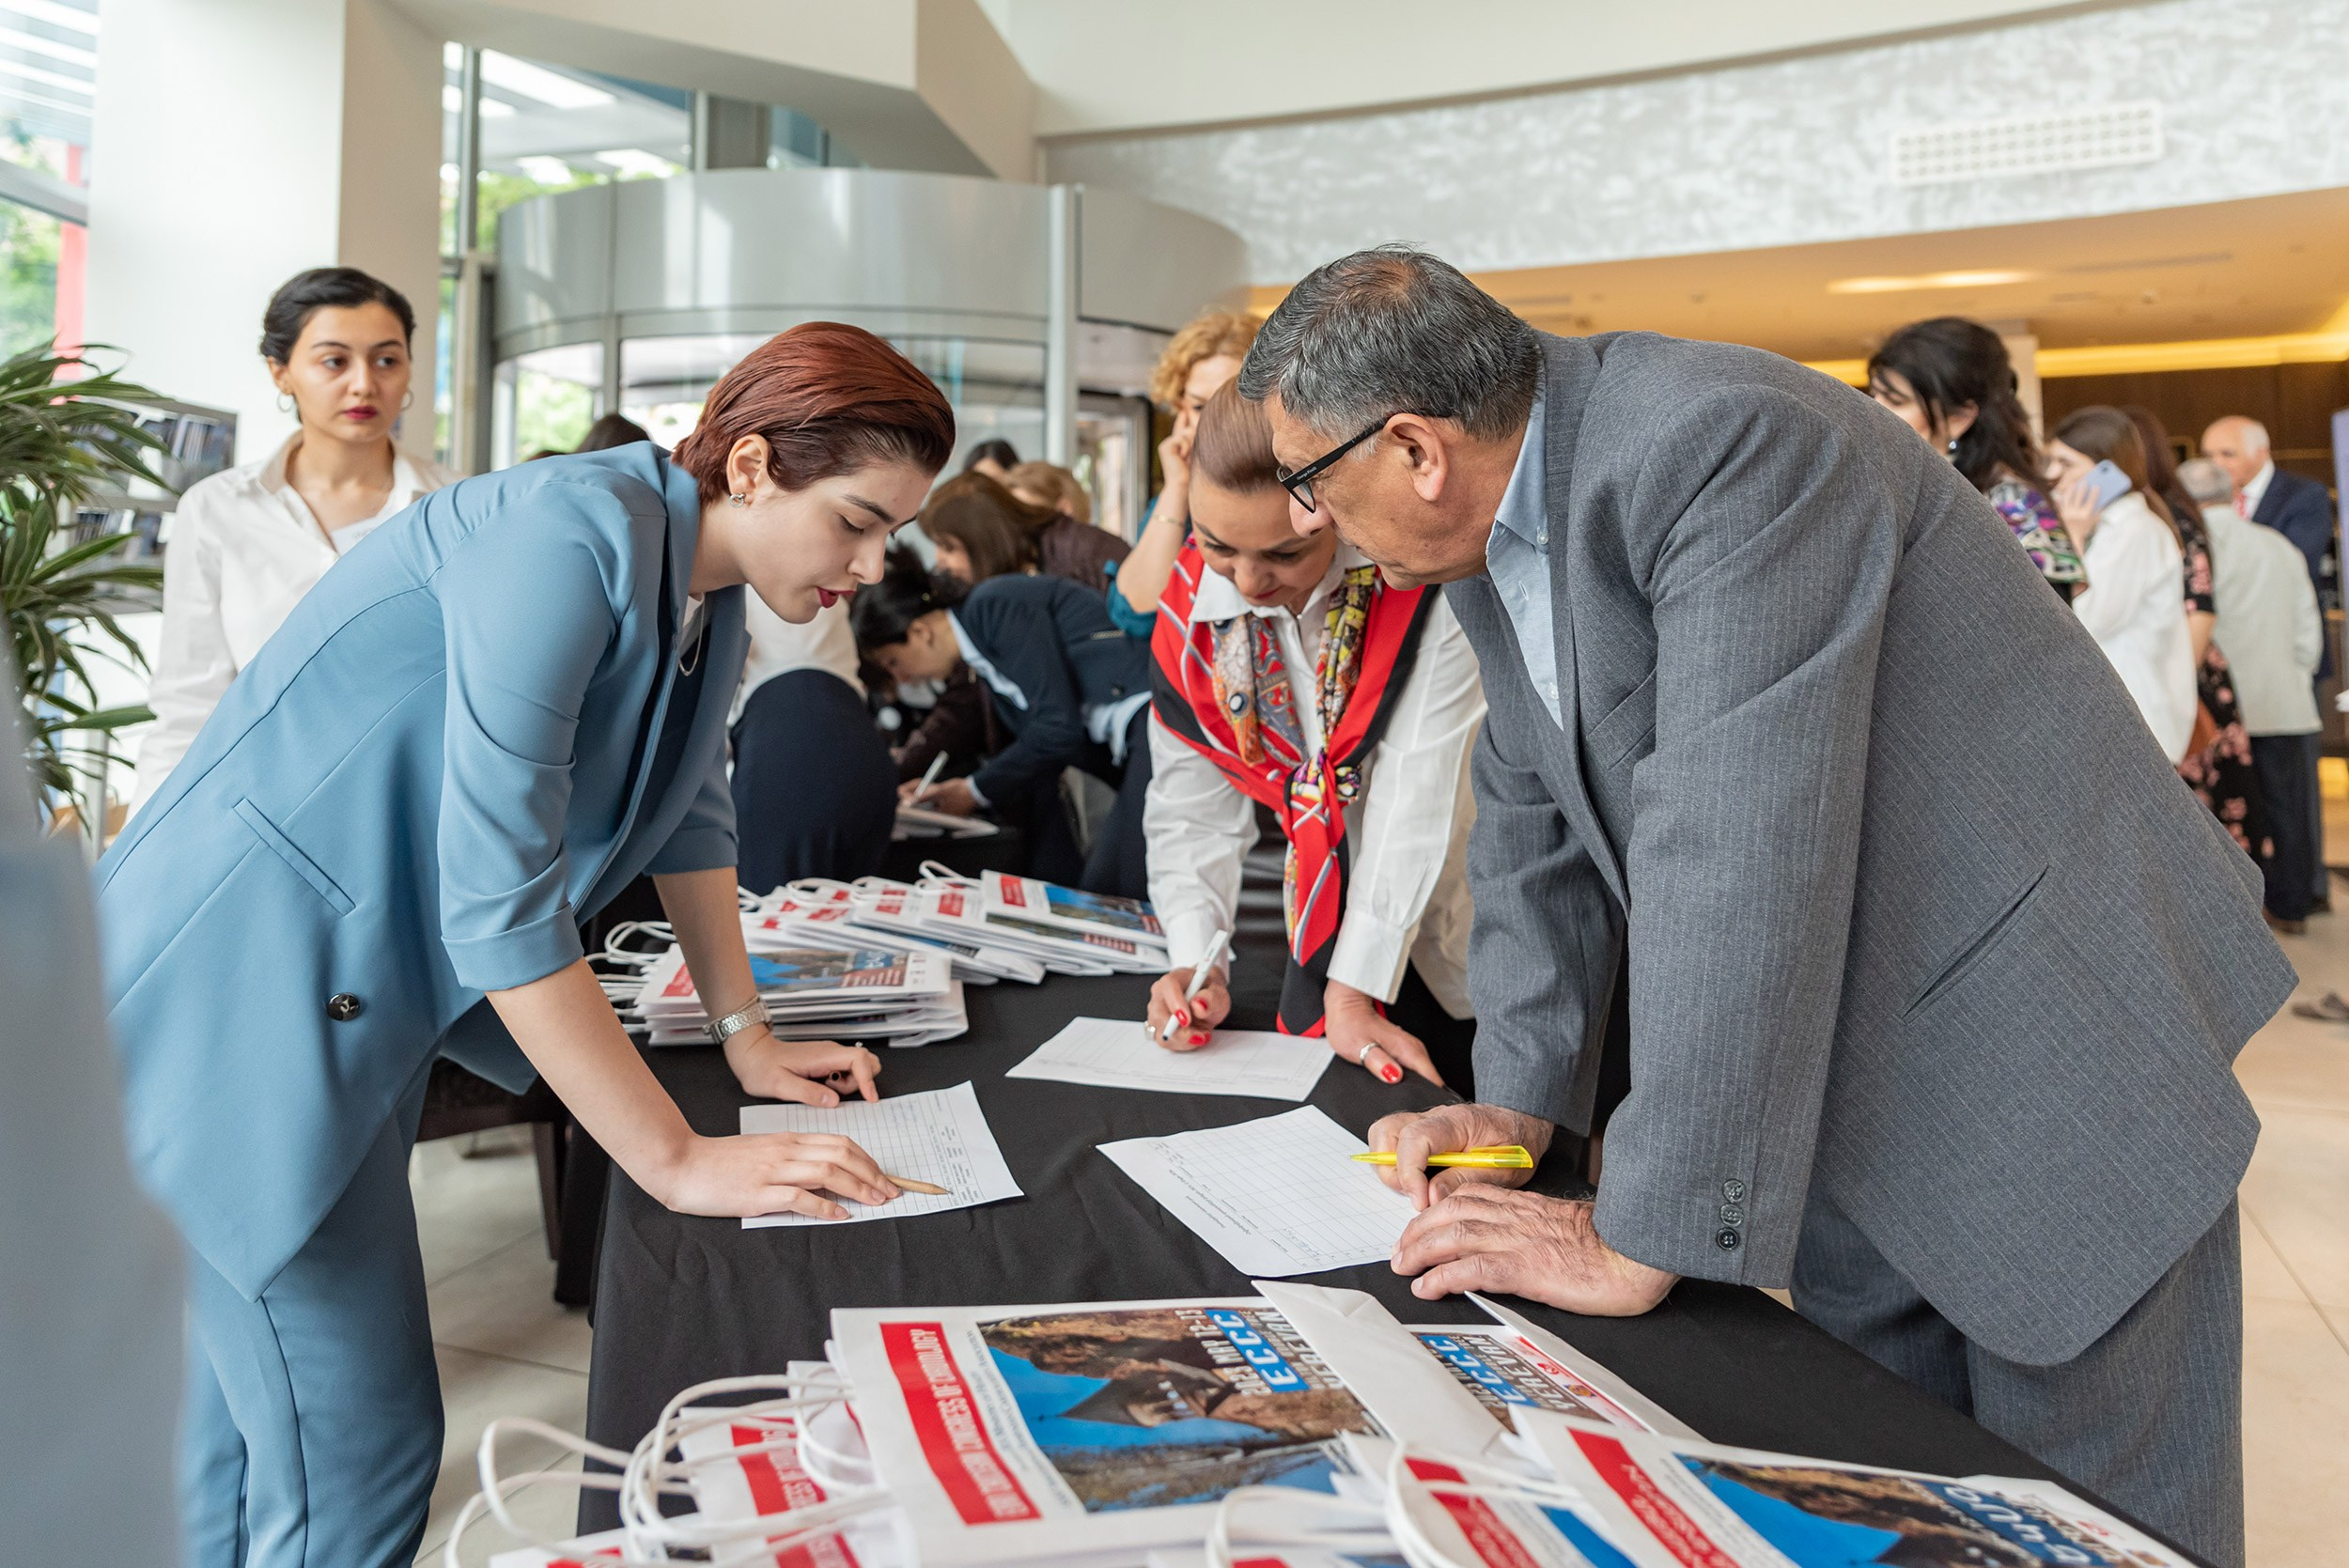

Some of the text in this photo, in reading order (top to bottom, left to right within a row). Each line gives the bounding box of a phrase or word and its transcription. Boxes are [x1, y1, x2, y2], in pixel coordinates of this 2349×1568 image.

[1200, 1339, 1245, 1365] MAY
[1213, 1313, 1299, 1386] ECCC
[1428, 1339, 1528, 1402] ECCC
[1462, 1335, 1578, 1410] YEREVAN
